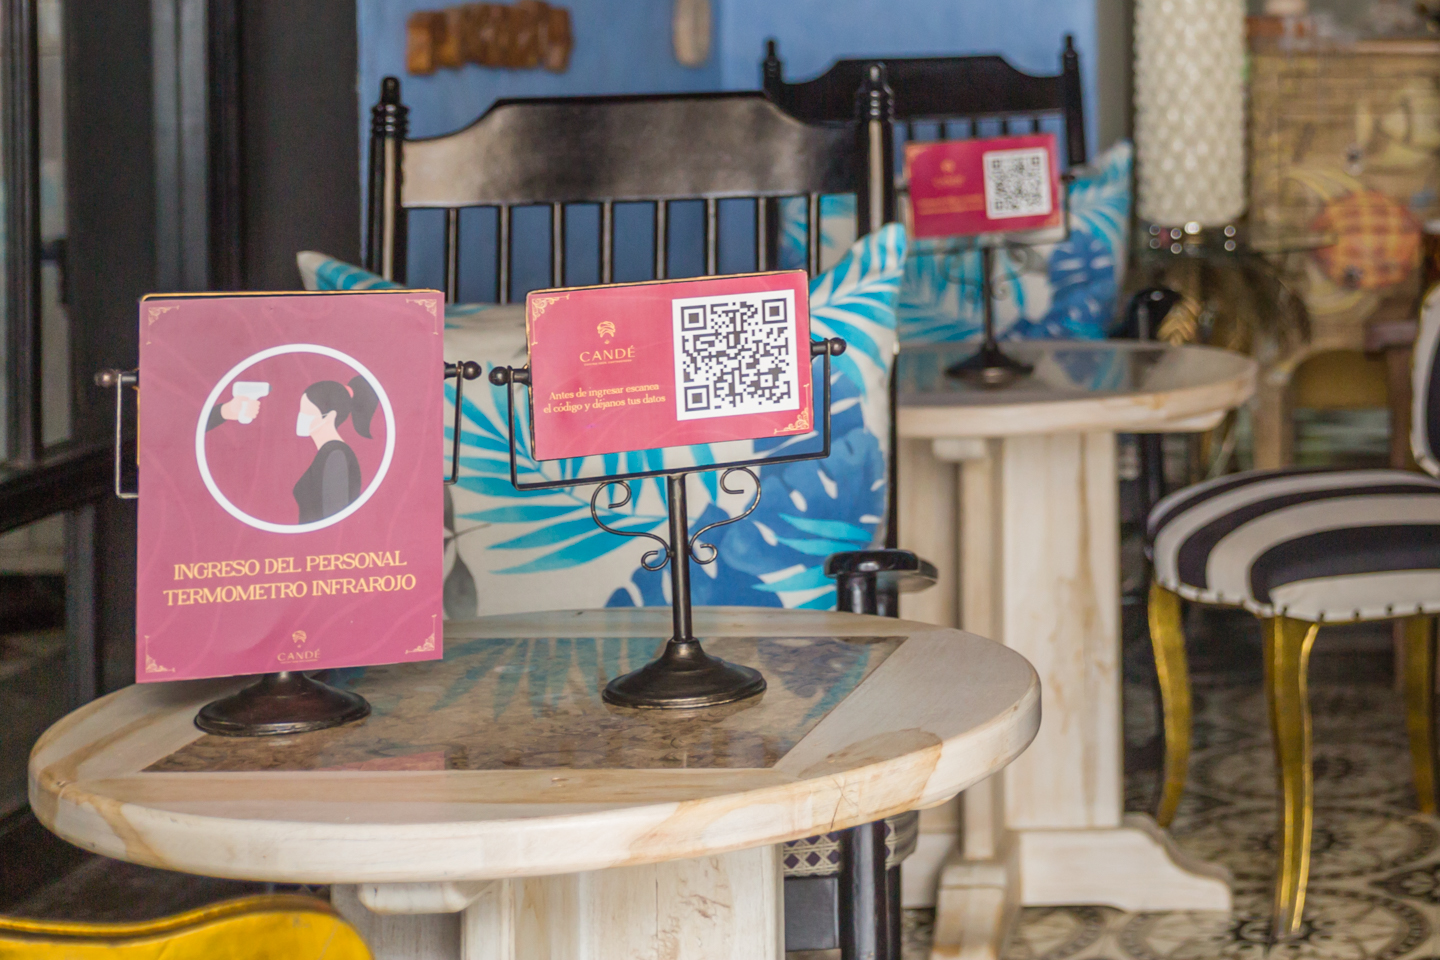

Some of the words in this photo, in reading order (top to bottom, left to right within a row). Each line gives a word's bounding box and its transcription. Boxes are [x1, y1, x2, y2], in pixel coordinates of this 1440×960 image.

[579, 345, 636, 363] CANDÉ
[549, 391, 575, 401] Antes
[576, 387, 587, 398] de
[588, 386, 624, 398] ingresar
[625, 384, 660, 393] escanea
[543, 403, 552, 414] el
[553, 401, 583, 414] código
[584, 402, 591, 412] y
[627, 396, 641, 405] tus
[642, 393, 666, 404] datos
[173, 559, 260, 580] INGRESO
[264, 556, 302, 575] DEL
[305, 550, 407, 572] PERSONAL
[163, 581, 308, 606] TERMOMETRO
[312, 573, 417, 596] INFRAROJO
[277, 648, 320, 662] CANDÉ
